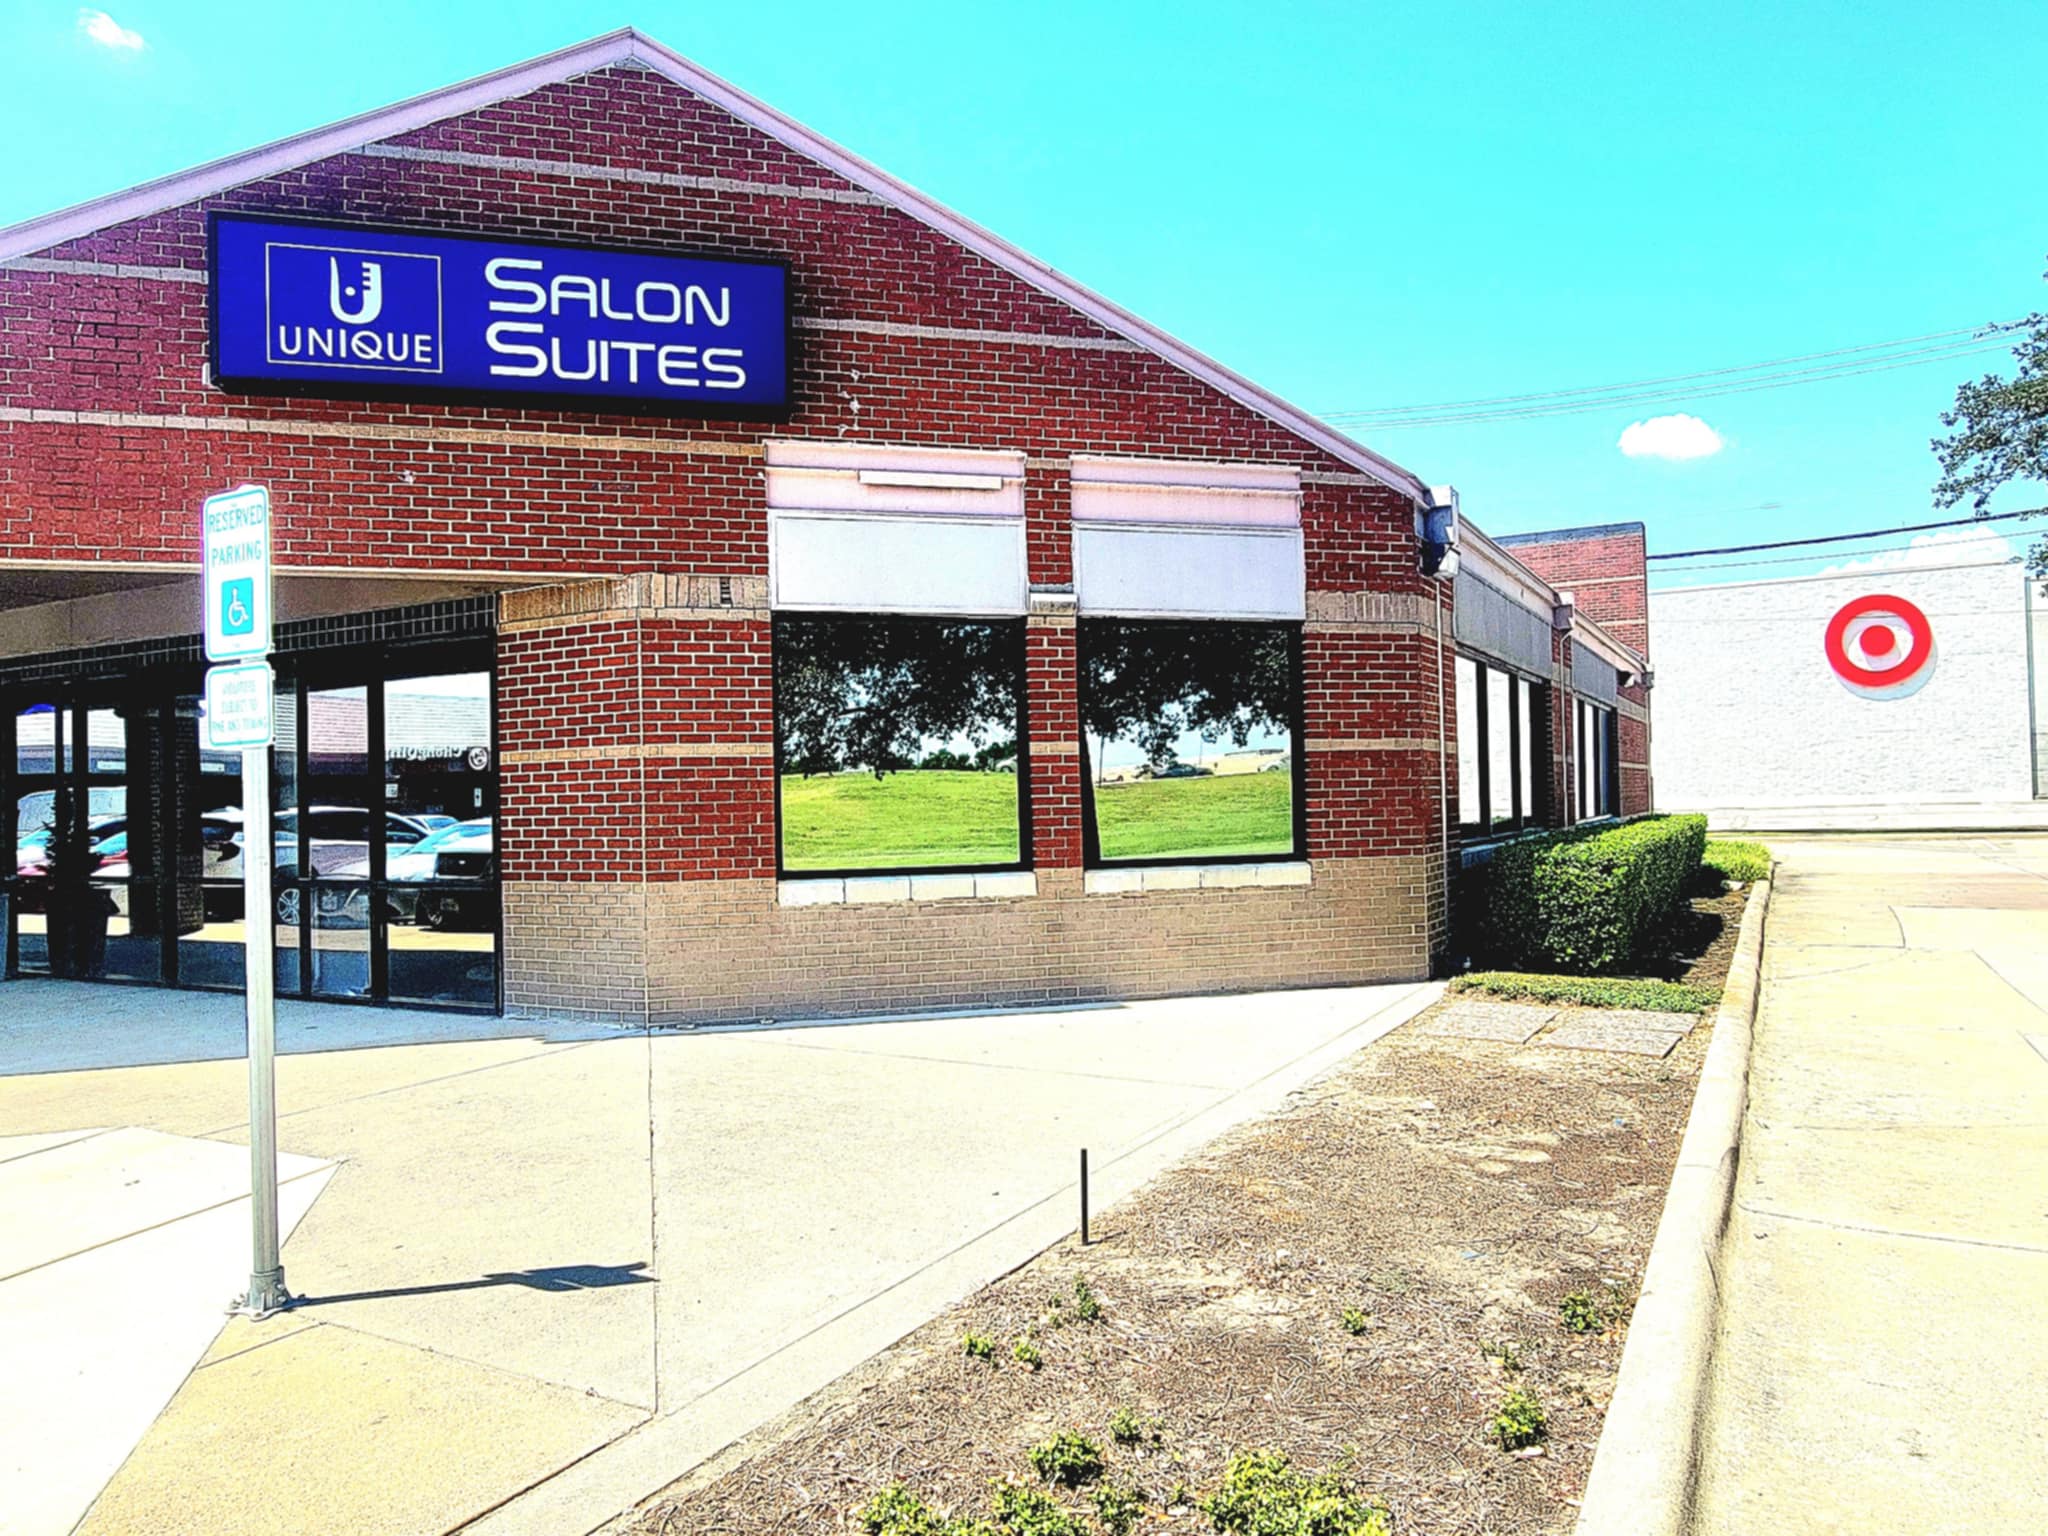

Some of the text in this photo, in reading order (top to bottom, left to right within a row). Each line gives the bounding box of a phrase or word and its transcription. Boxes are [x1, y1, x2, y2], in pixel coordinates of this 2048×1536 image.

[484, 257, 730, 327] SALON
[279, 325, 432, 363] UNIQUE
[485, 321, 746, 389] SUITES
[208, 504, 263, 533] RESERVED
[211, 540, 262, 568] PARKING
